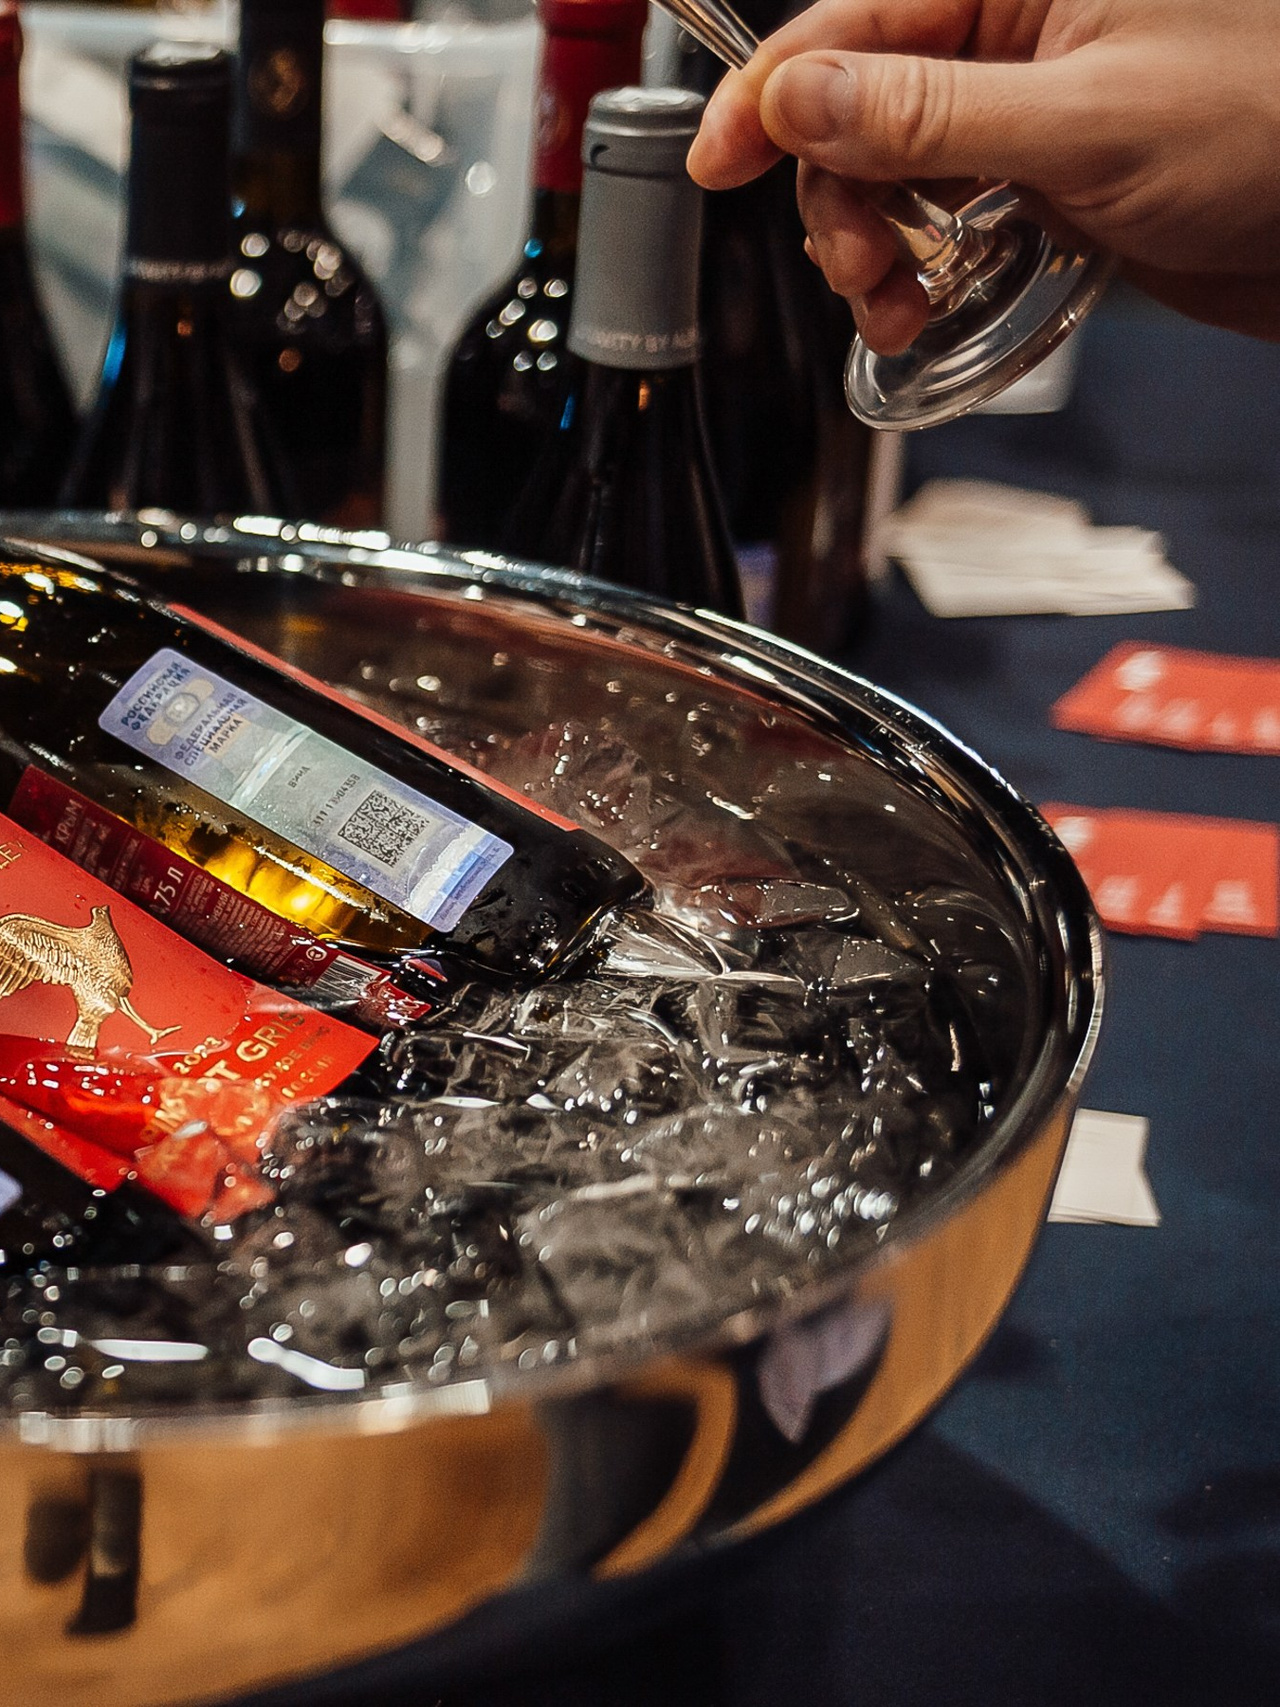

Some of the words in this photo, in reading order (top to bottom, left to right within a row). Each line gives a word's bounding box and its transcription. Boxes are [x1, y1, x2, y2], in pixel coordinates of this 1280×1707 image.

[174, 692, 237, 760] ФЕДЕРАЛЬНАЯ
[184, 697, 249, 766] СПЕЦИАЛЬНАЯ
[209, 718, 243, 753] МАРКА
[236, 1010, 306, 1062] GRIS
